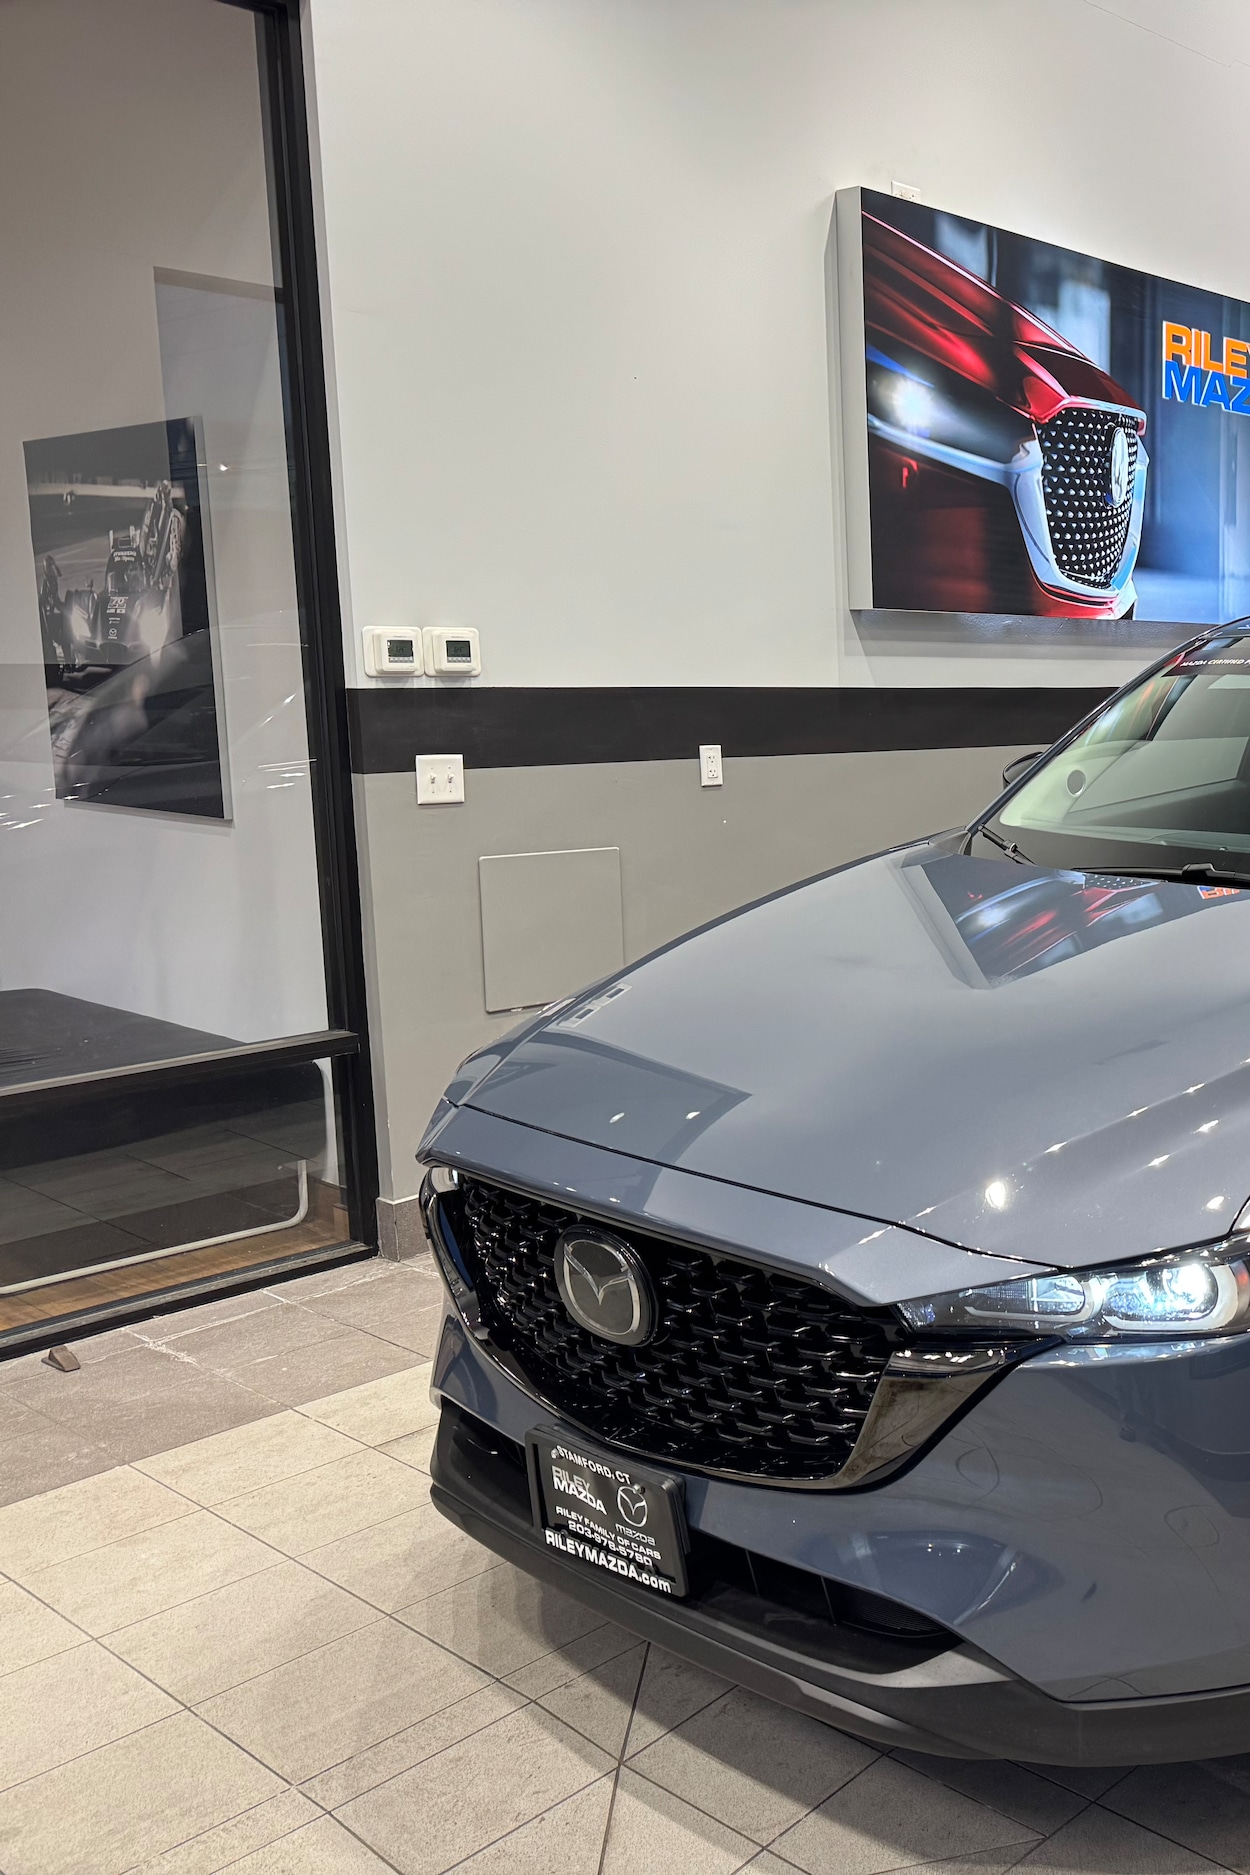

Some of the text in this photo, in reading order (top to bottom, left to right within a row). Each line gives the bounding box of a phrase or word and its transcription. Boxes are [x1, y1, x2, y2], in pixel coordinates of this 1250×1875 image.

[552, 1465, 590, 1494] RILEY
[557, 1445, 631, 1485] STAMFORD, CT
[553, 1477, 607, 1515] MAZDA
[556, 1506, 662, 1560] RILEY FAMILY OF CARS
[545, 1529, 672, 1594] RILEYMAZDA.com
